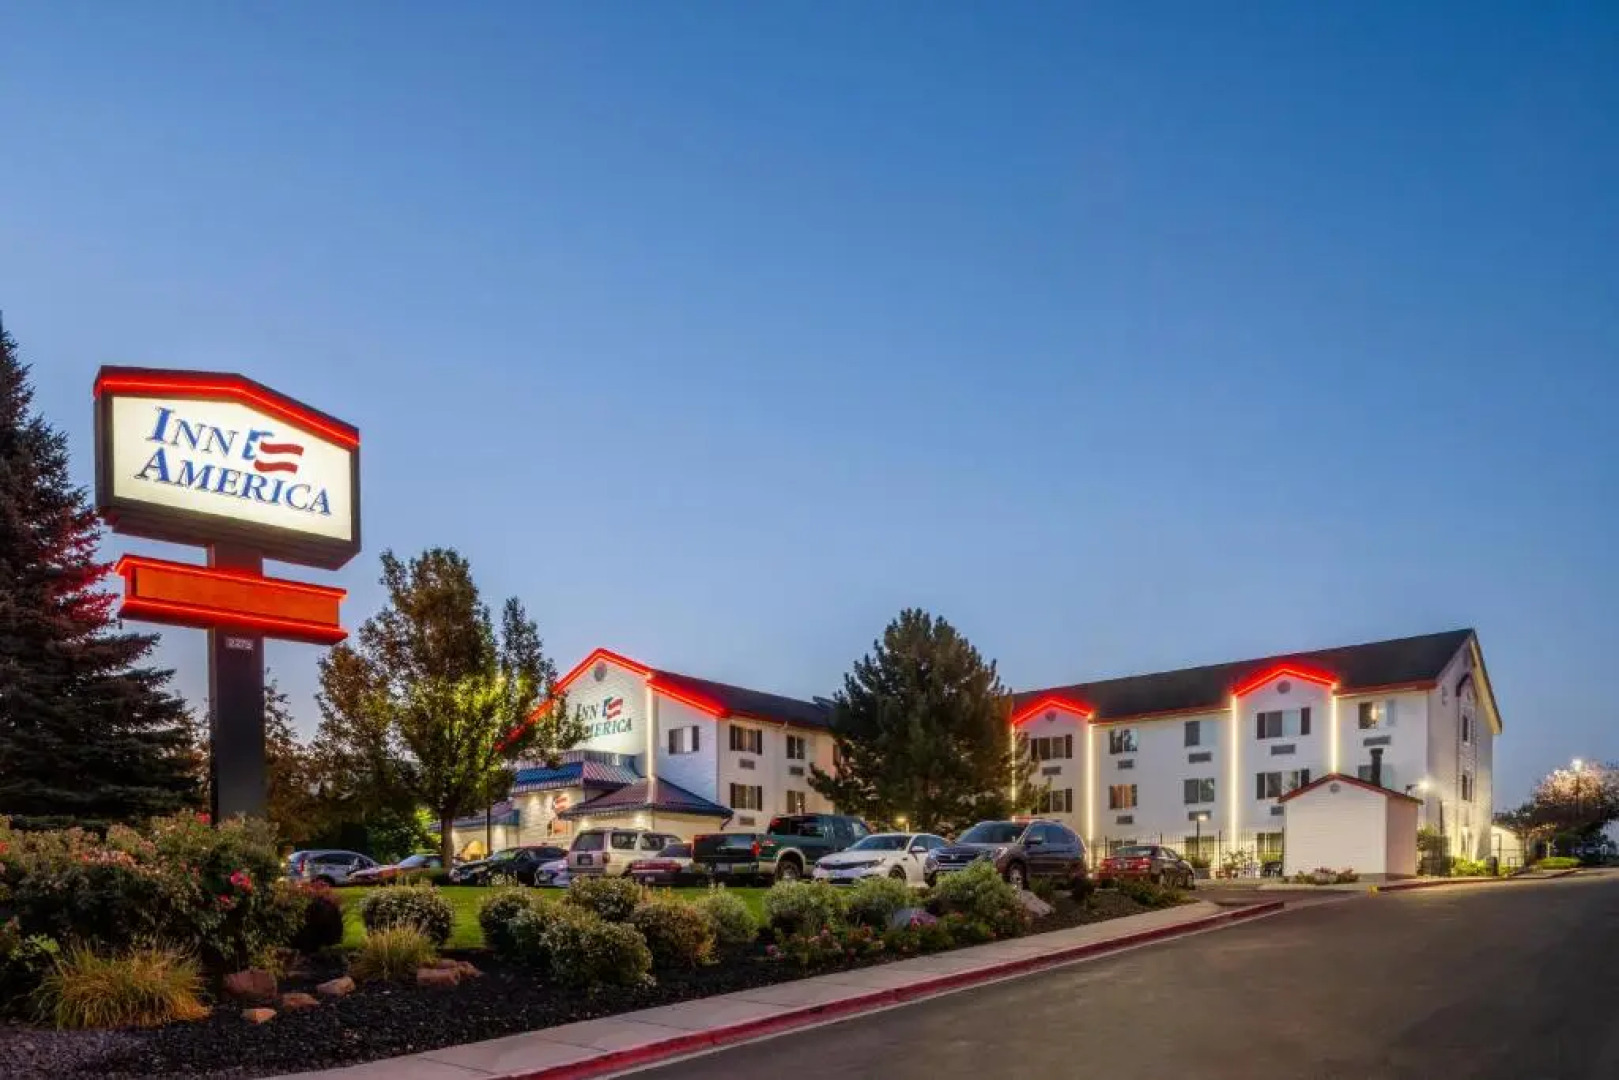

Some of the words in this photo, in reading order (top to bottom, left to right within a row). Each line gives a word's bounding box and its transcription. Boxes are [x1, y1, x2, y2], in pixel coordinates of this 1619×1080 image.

[145, 405, 240, 460] INN
[133, 446, 333, 516] AMERICA
[575, 702, 599, 722] INN
